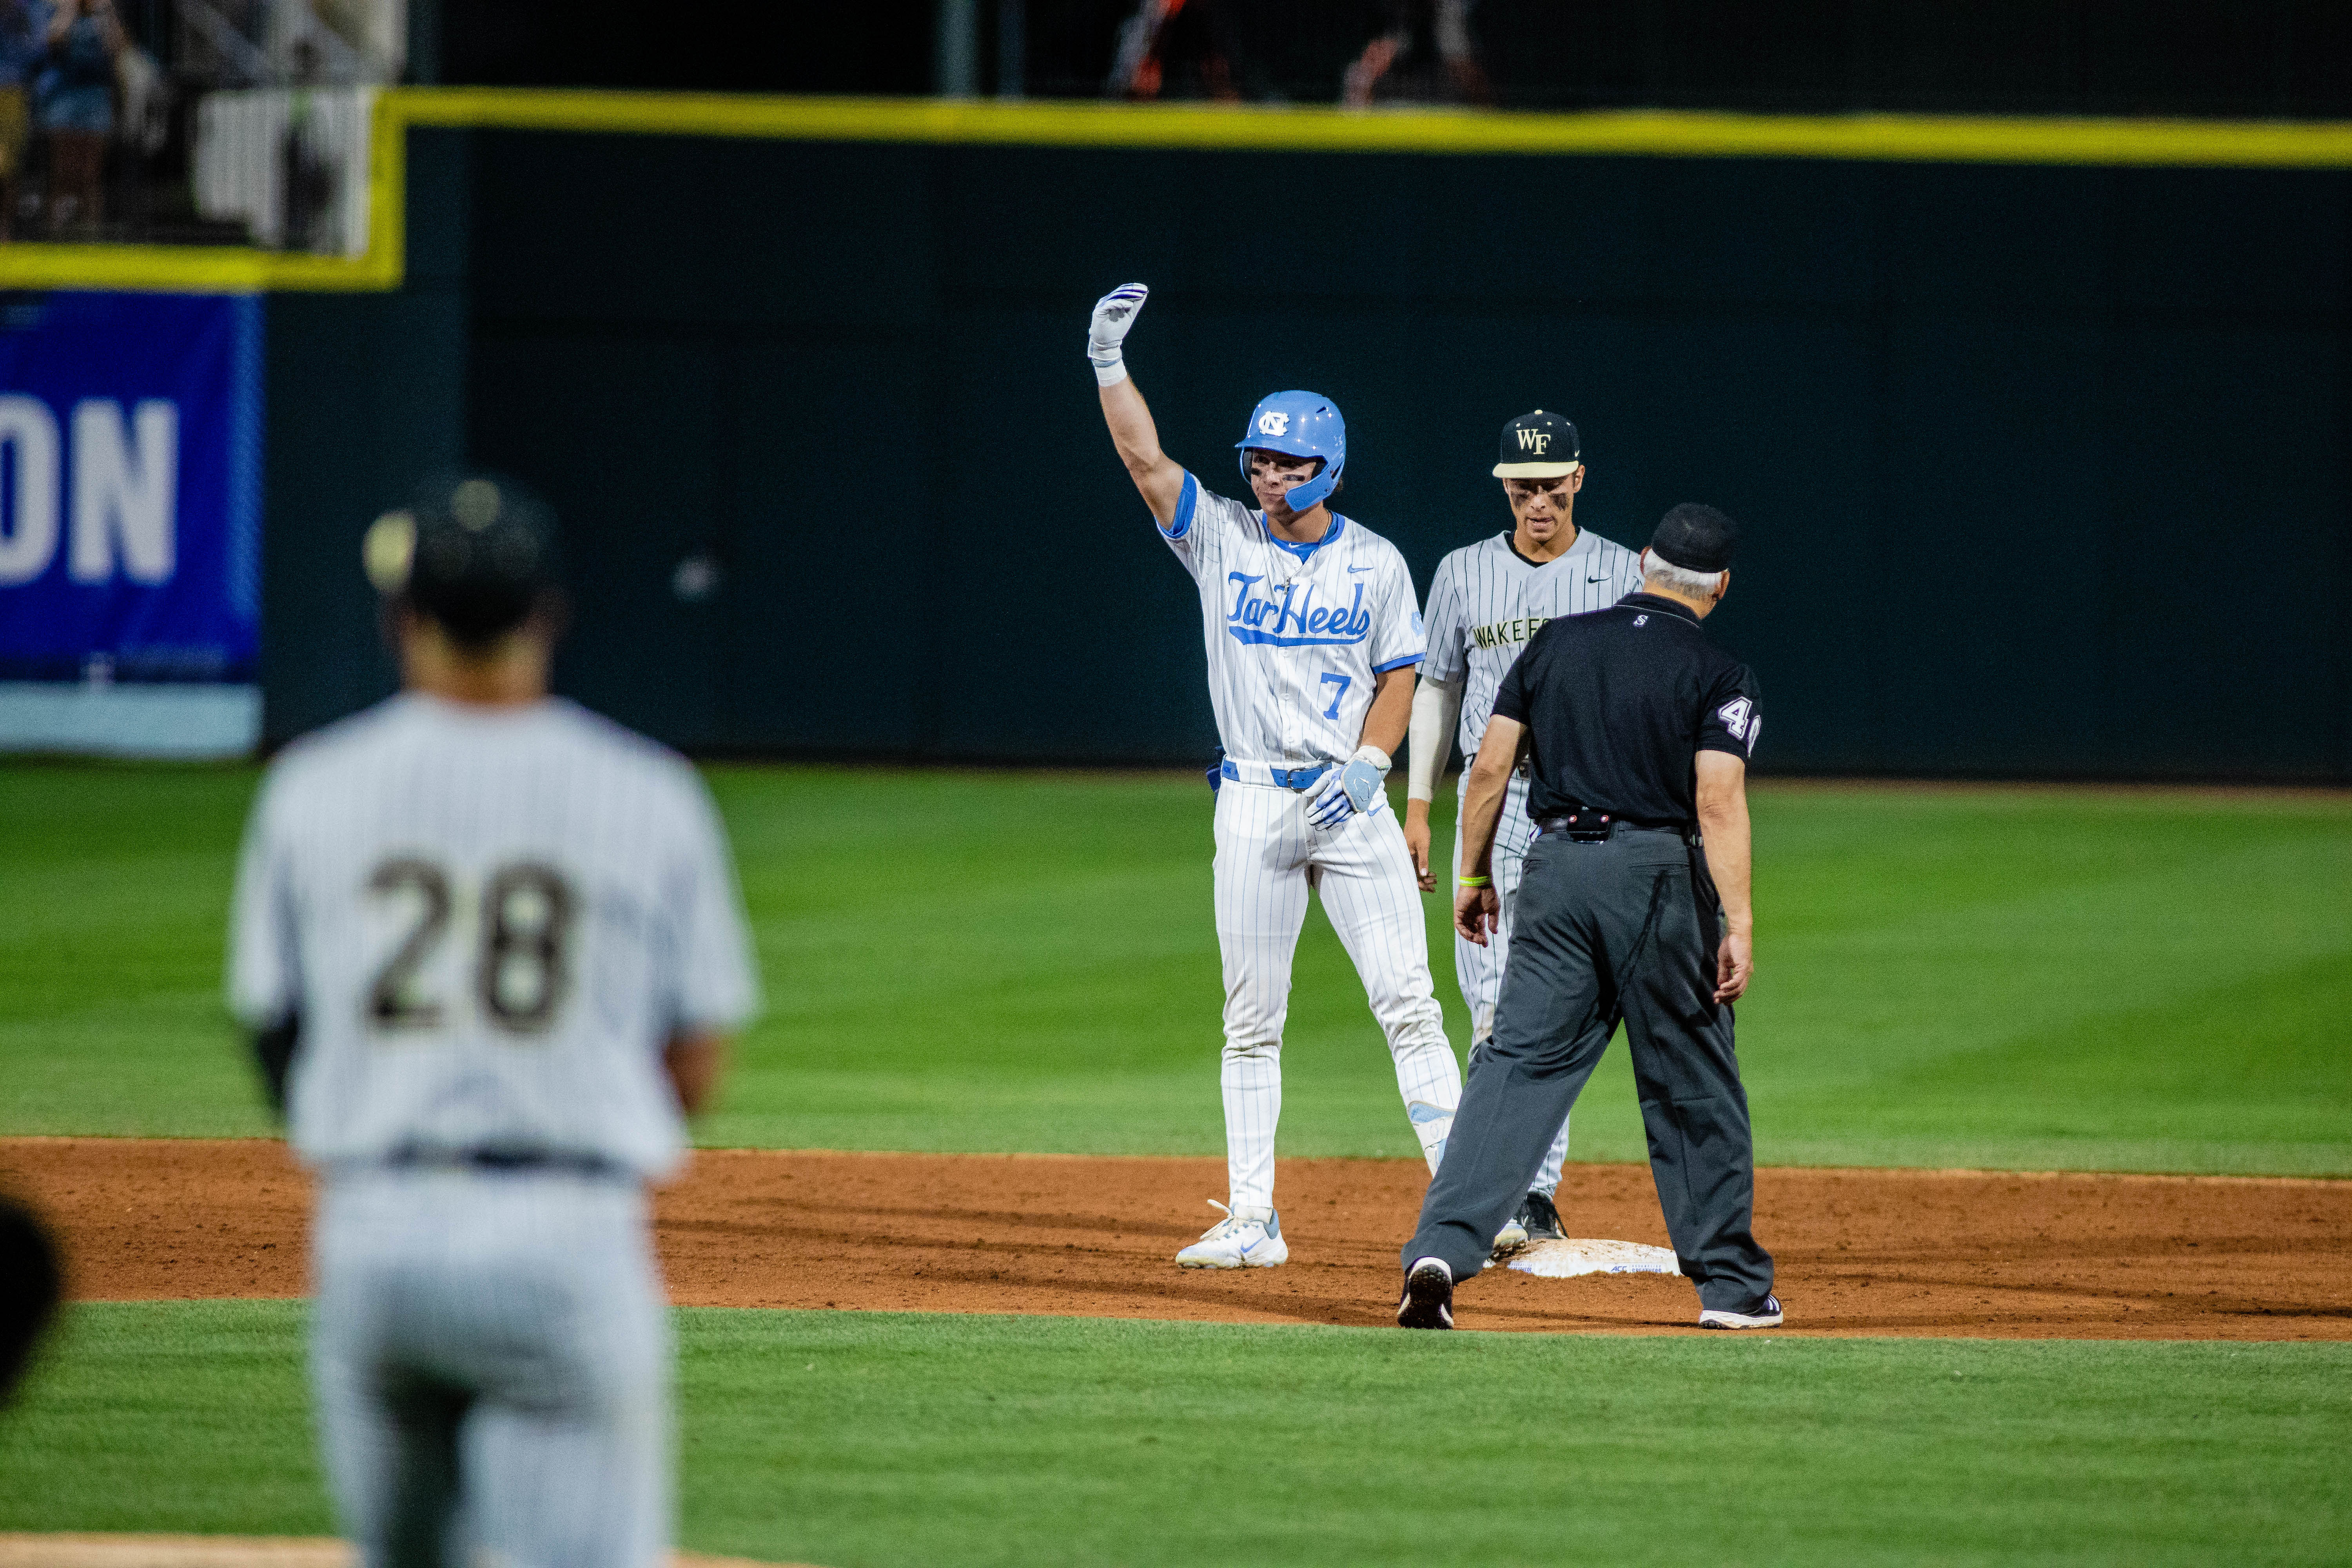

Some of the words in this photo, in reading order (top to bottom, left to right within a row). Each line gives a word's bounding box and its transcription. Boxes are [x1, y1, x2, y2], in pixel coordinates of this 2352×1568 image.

[1516, 428, 1551, 454] WF
[1320, 672, 1352, 720] 7
[359, 855, 582, 1039] 28
